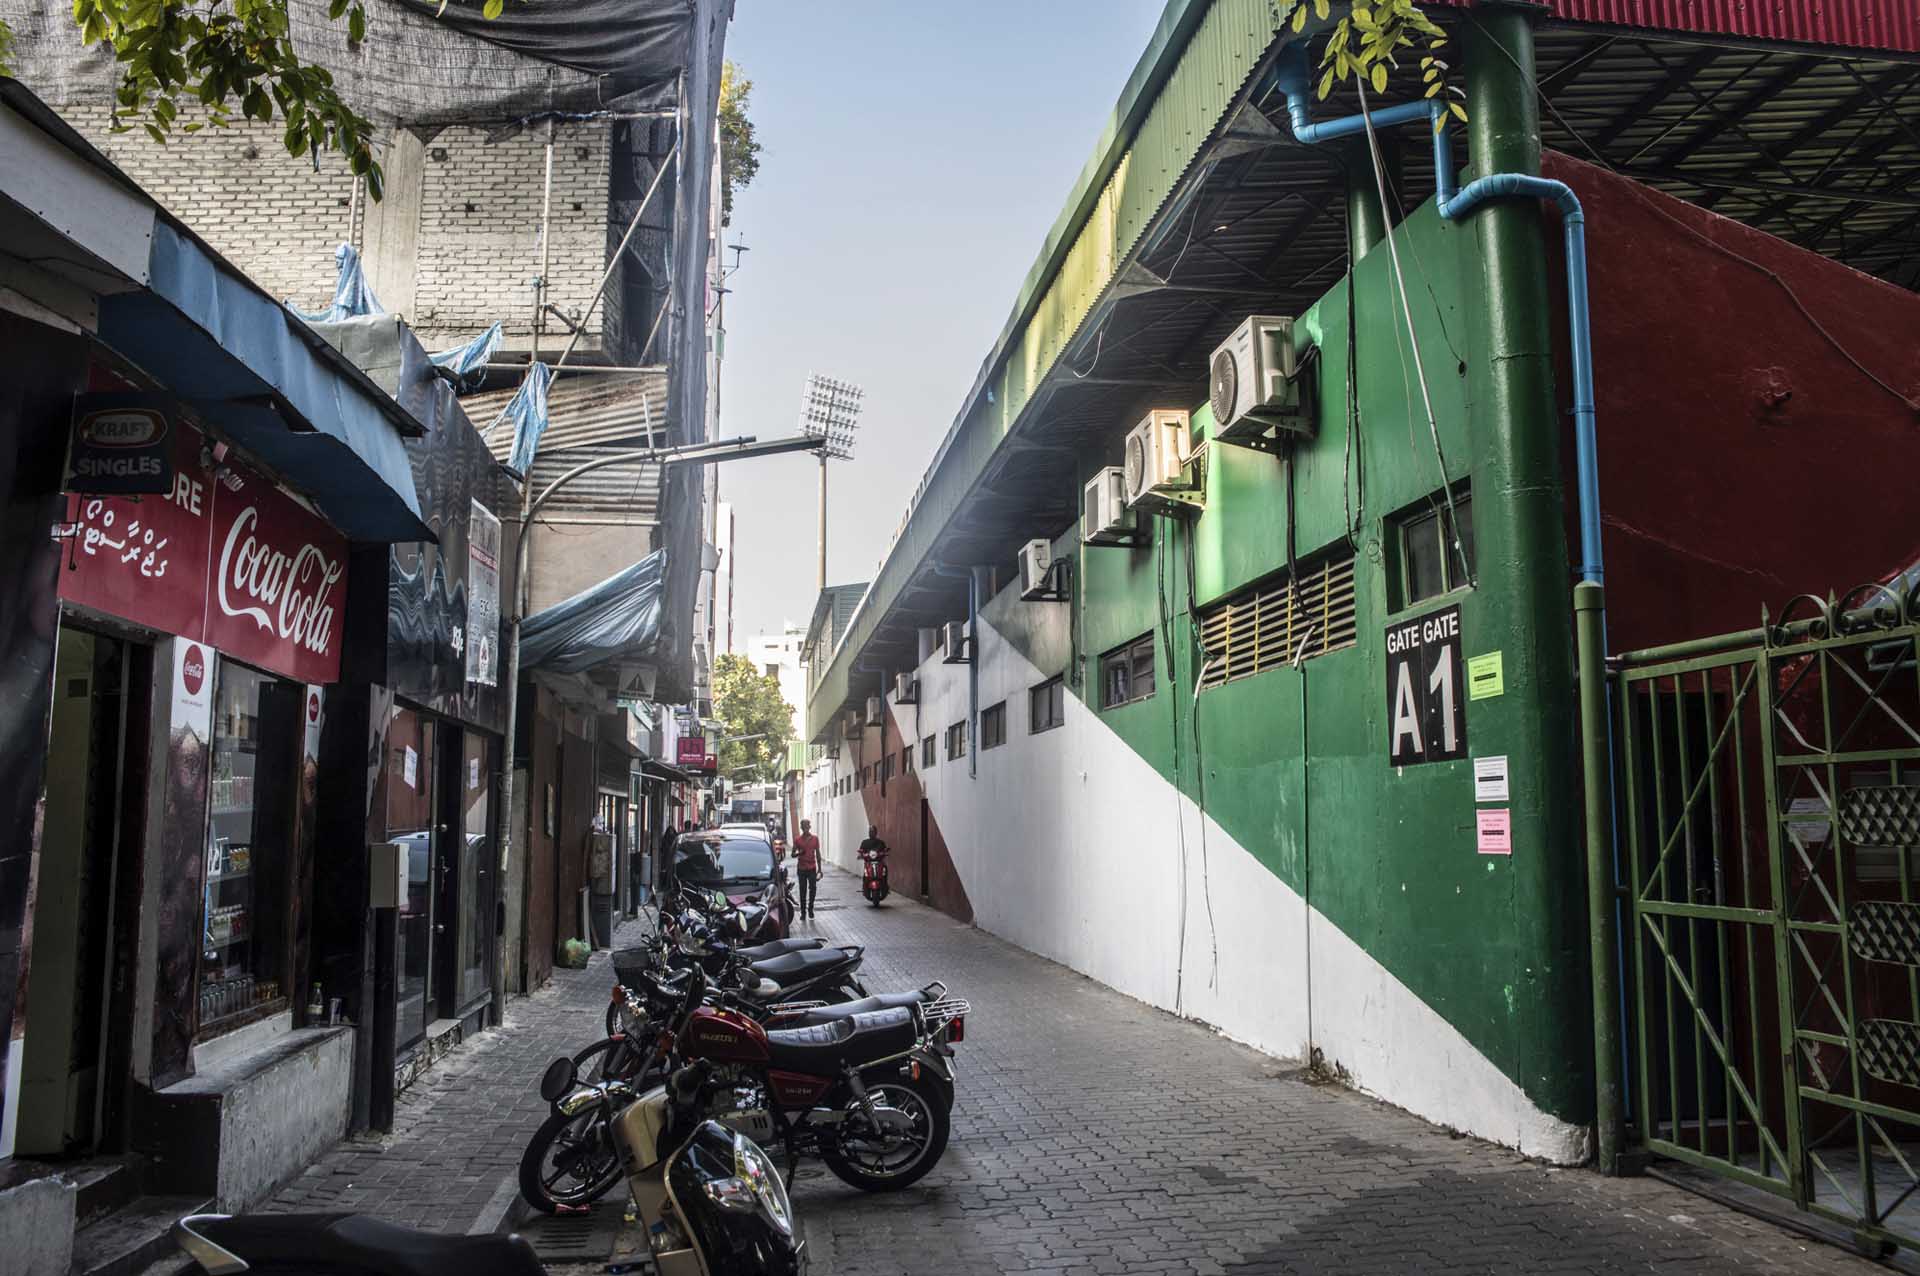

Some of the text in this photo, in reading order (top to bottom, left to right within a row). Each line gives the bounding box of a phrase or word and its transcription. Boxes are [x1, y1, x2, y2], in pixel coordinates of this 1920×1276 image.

[95, 421, 151, 437] KRAFT
[77, 456, 162, 478] SINGLES
[218, 505, 344, 656] Coca-Cola
[1387, 612, 1459, 654] GATE GATE
[1391, 643, 1457, 756] A 1
